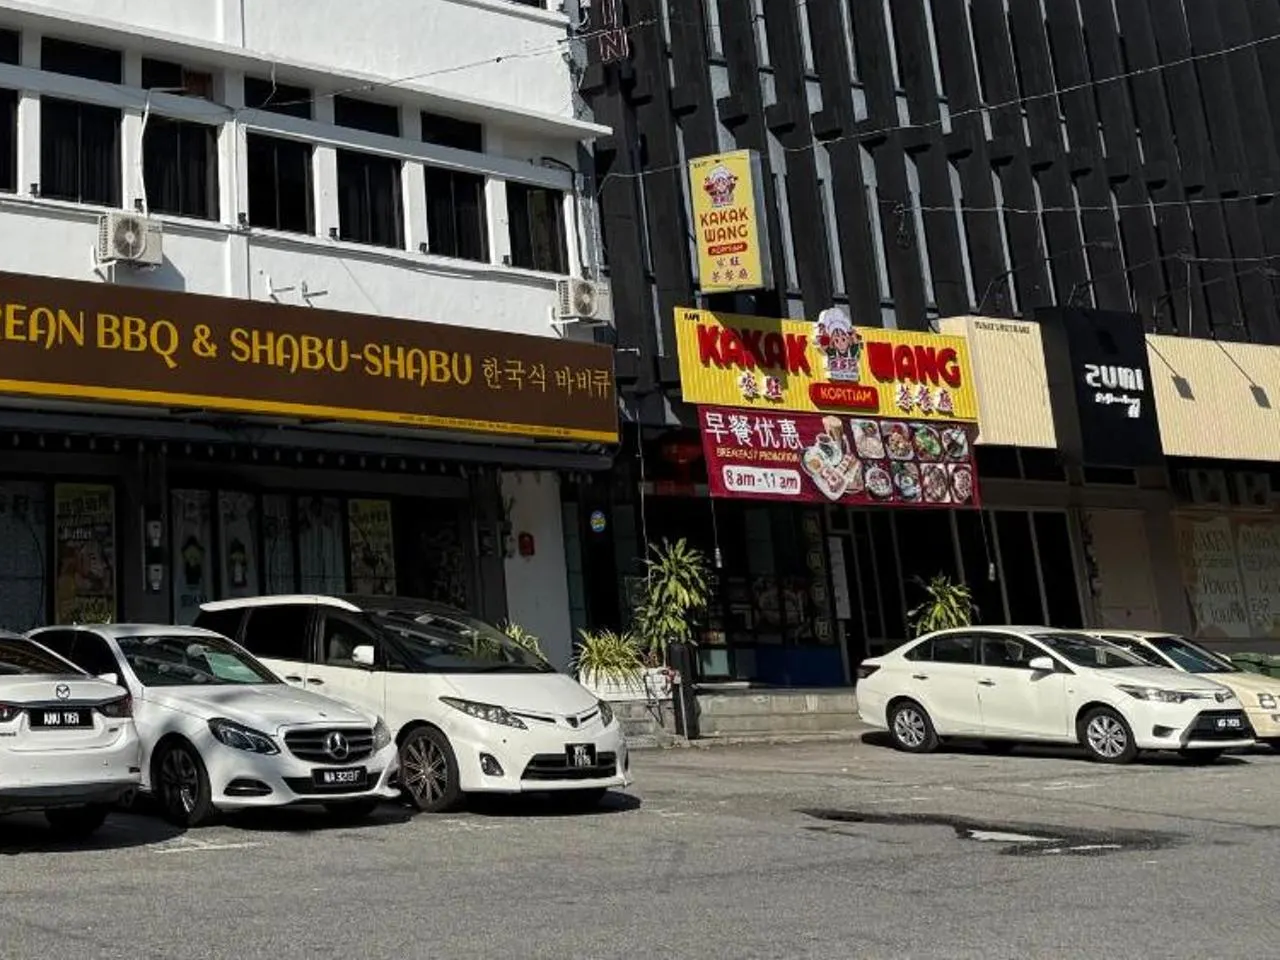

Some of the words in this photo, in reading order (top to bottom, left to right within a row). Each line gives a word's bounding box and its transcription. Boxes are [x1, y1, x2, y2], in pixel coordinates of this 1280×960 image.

[699, 207, 749, 227] KAKAK
[703, 224, 749, 243] WANG
[96, 312, 179, 369] BBQ
[192, 323, 218, 359] &
[230, 327, 472, 387] SHABU-SHABU
[481, 356, 547, 393] 한국식
[555, 365, 612, 400] 바비큐
[696, 323, 811, 377] KAKAK
[866, 341, 961, 388] WANG
[820, 387, 873, 402] KOPITIAM
[705, 411, 804, 449] 早餐优惠
[725, 468, 734, 486] 8
[736, 473, 756, 487] am
[779, 476, 798, 489] am
